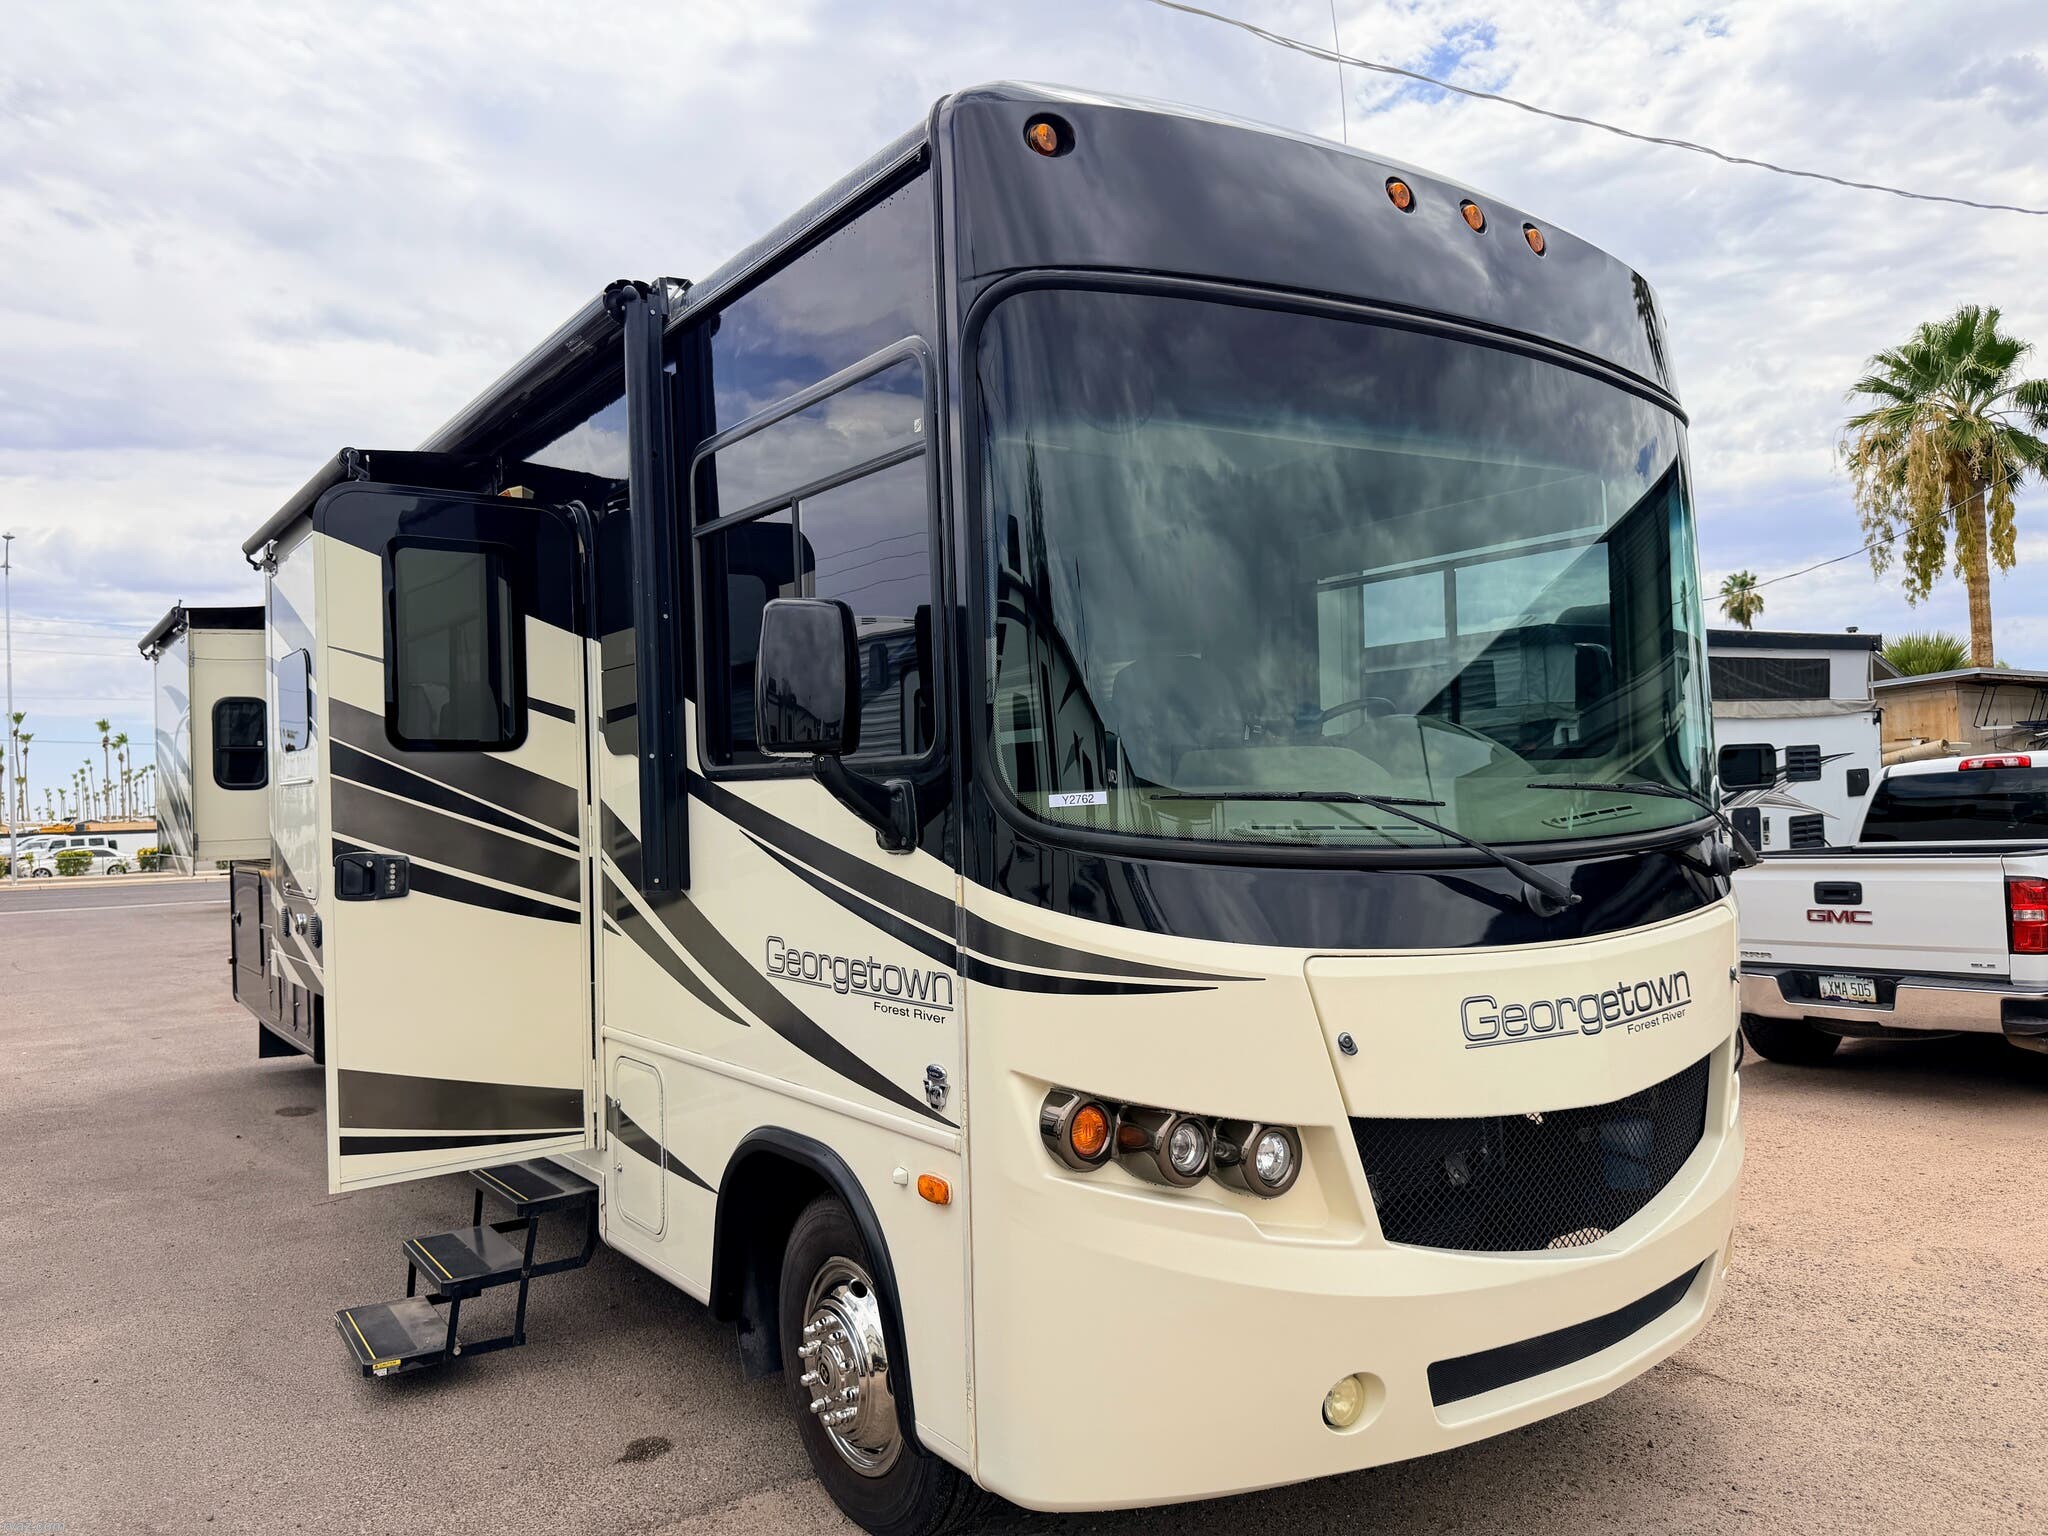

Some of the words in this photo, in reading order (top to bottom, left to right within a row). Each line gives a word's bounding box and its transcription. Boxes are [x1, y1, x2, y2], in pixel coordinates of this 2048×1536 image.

[1062, 794, 1095, 805] Y2762
[1806, 909, 1873, 926] GMC
[766, 936, 953, 1004] Georgetown
[873, 1001, 910, 1018] Forest
[913, 1008, 946, 1025] River
[1460, 970, 1691, 1042] Georgetown
[1627, 1019, 1661, 1035] Forest
[1662, 1007, 1687, 1024] River
